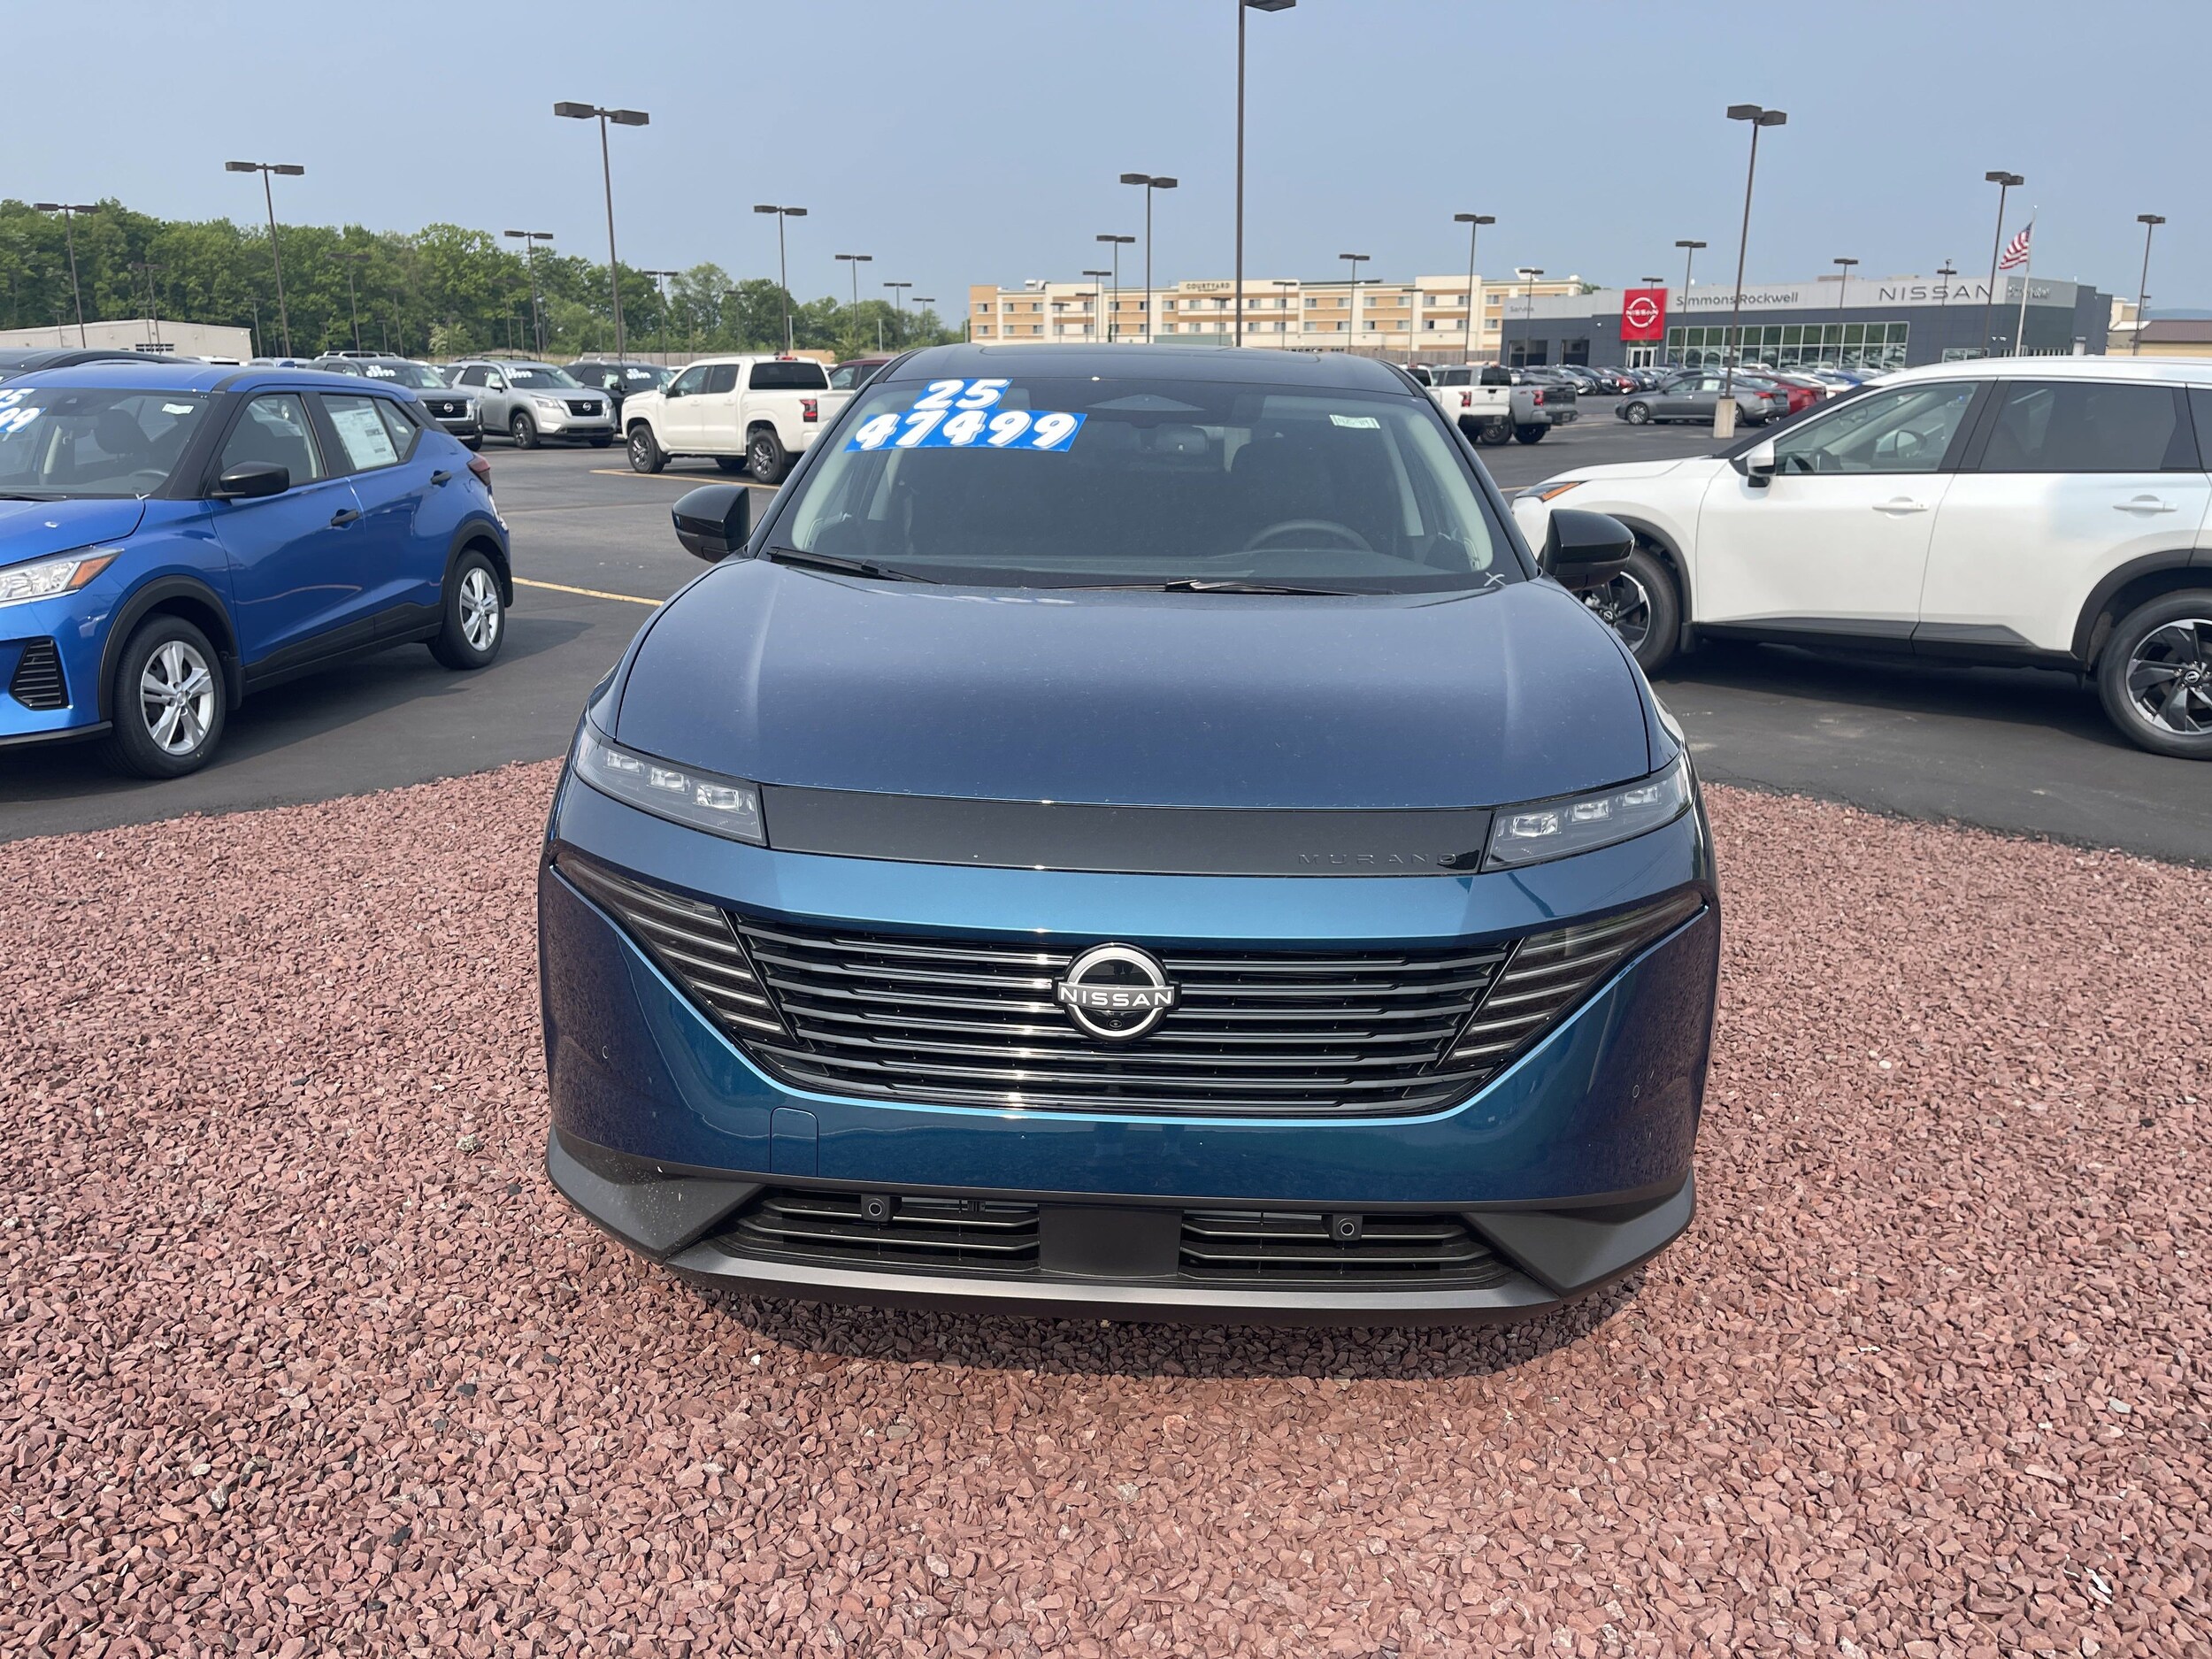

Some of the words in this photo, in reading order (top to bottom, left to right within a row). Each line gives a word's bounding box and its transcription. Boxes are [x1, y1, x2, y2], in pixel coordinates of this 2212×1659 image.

[1878, 284, 1992, 301] NISSAN
[913, 379, 1010, 410] 25
[855, 409, 1078, 450] 47499
[1298, 853, 1457, 865] MURANO
[1060, 987, 1171, 1007] NISSAN
